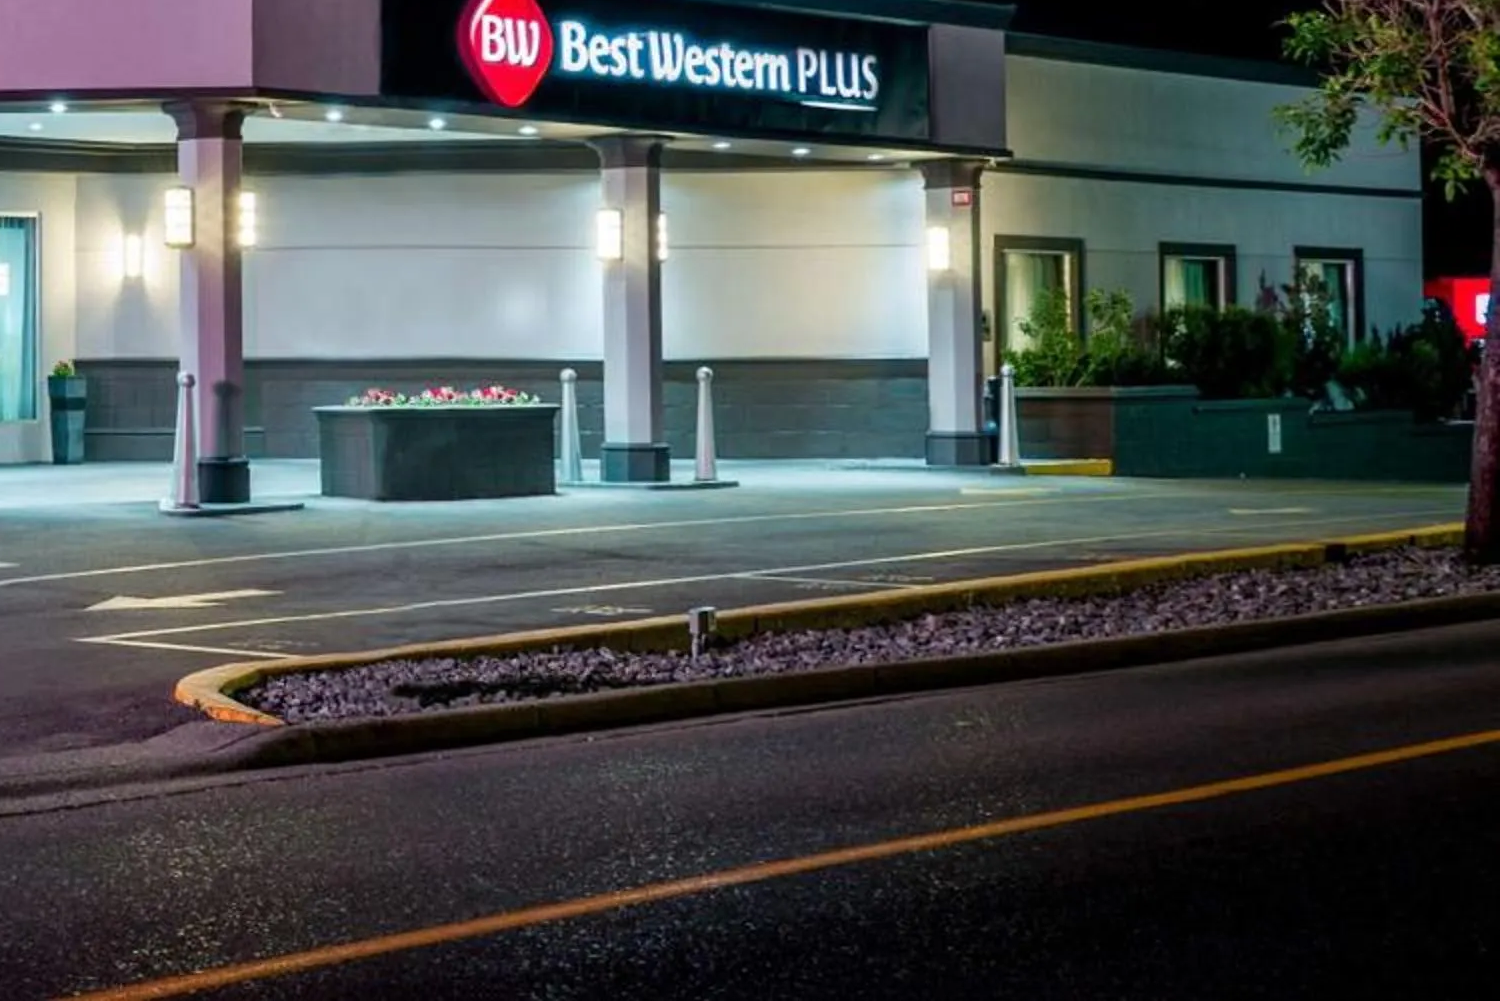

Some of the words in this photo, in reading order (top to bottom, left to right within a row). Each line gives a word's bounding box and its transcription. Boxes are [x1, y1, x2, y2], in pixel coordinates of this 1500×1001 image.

[481, 14, 541, 67] BW
[560, 21, 645, 79] Best
[648, 31, 791, 93] Western
[797, 48, 879, 100] PLUS
